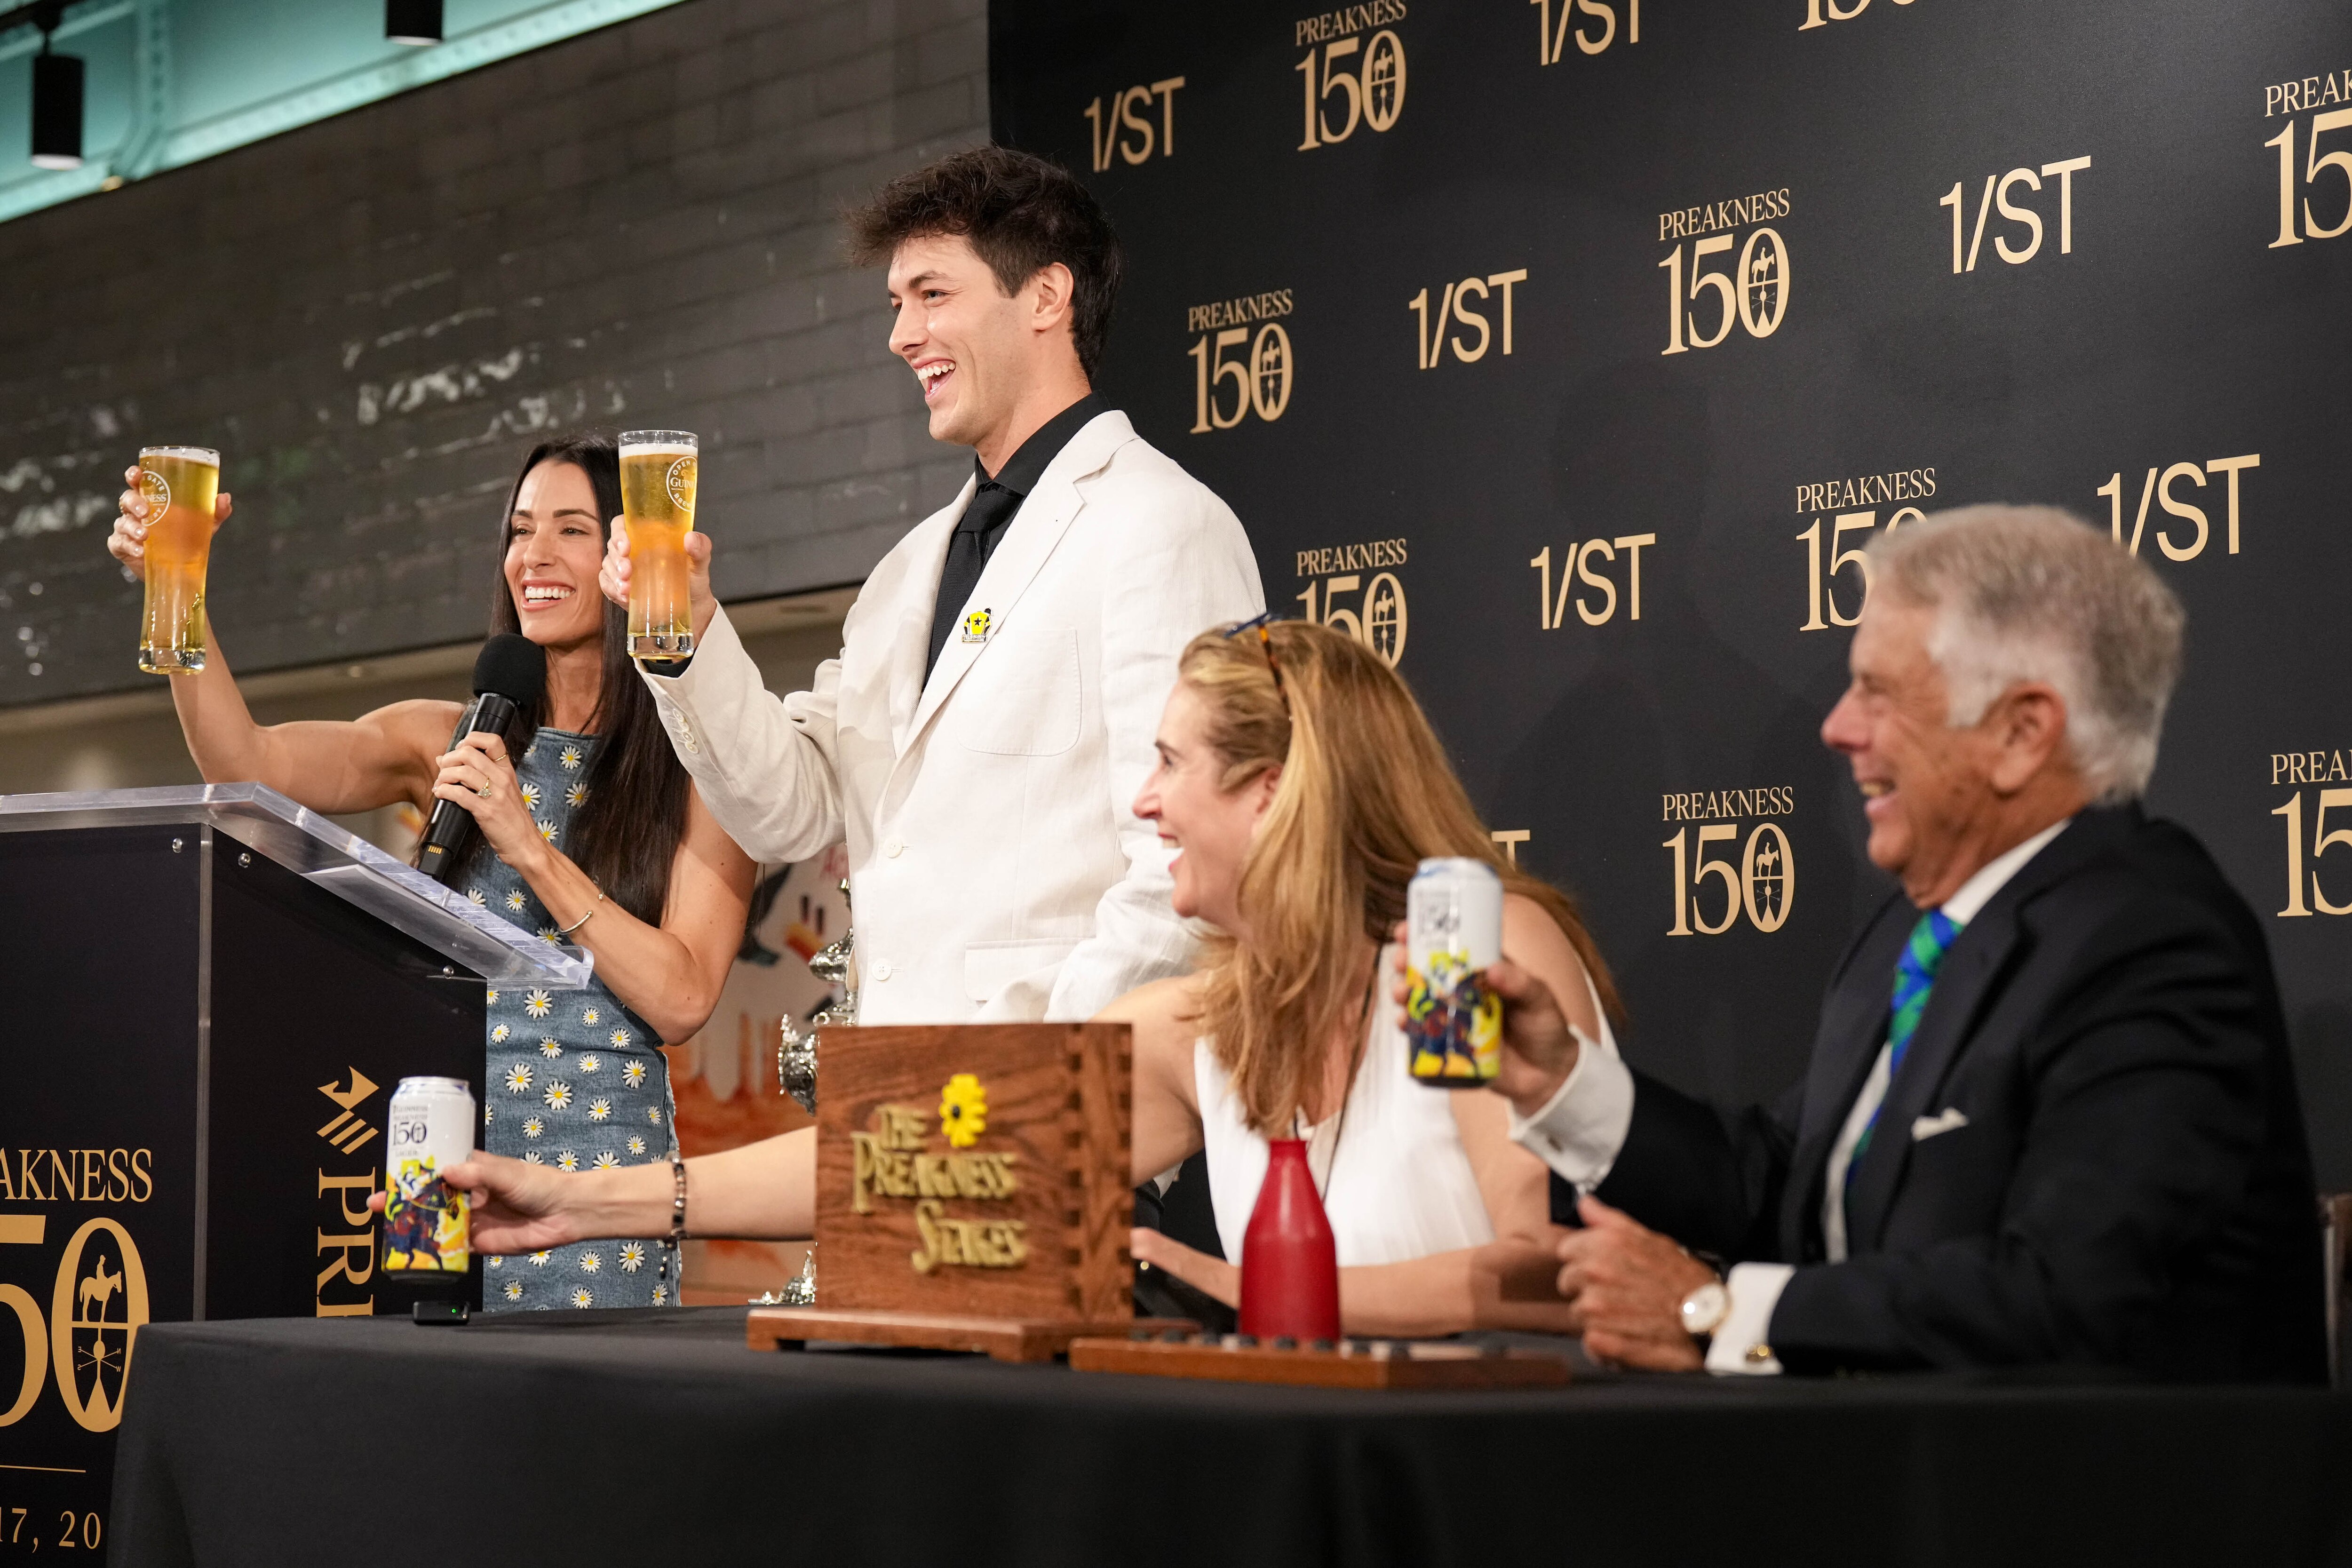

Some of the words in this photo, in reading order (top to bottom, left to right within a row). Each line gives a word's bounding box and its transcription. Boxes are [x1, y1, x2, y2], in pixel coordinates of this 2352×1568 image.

[1296, 0, 1406, 46] PREAKNESS
[1295, 30, 1406, 151] 150
[1085, 77, 1185, 172] 1/ST
[1659, 188, 1790, 241] PREAKNESS
[1939, 156, 2091, 274] 1/ST
[1188, 288, 1293, 332] PREAKNESS
[1659, 228, 1790, 355] 150
[1409, 268, 1527, 370] 1/ST
[1187, 323, 1293, 434] 150
[673, 460, 690, 475] OPEN
[1796, 468, 1936, 513] PREAKNESS
[2097, 454, 2260, 561] 1/ST
[1296, 538, 1407, 577] PREAKNESS
[1530, 533, 1656, 630] 1/ST
[1796, 507, 1928, 631] 15
[2271, 749, 2352, 784] PREA
[1662, 787, 1794, 820] PREAKNESS
[1662, 823, 1795, 936] 150
[393, 1122, 427, 1146] 150
[875, 1104, 929, 1149] THE
[59, 1511, 101, 1549] 20
